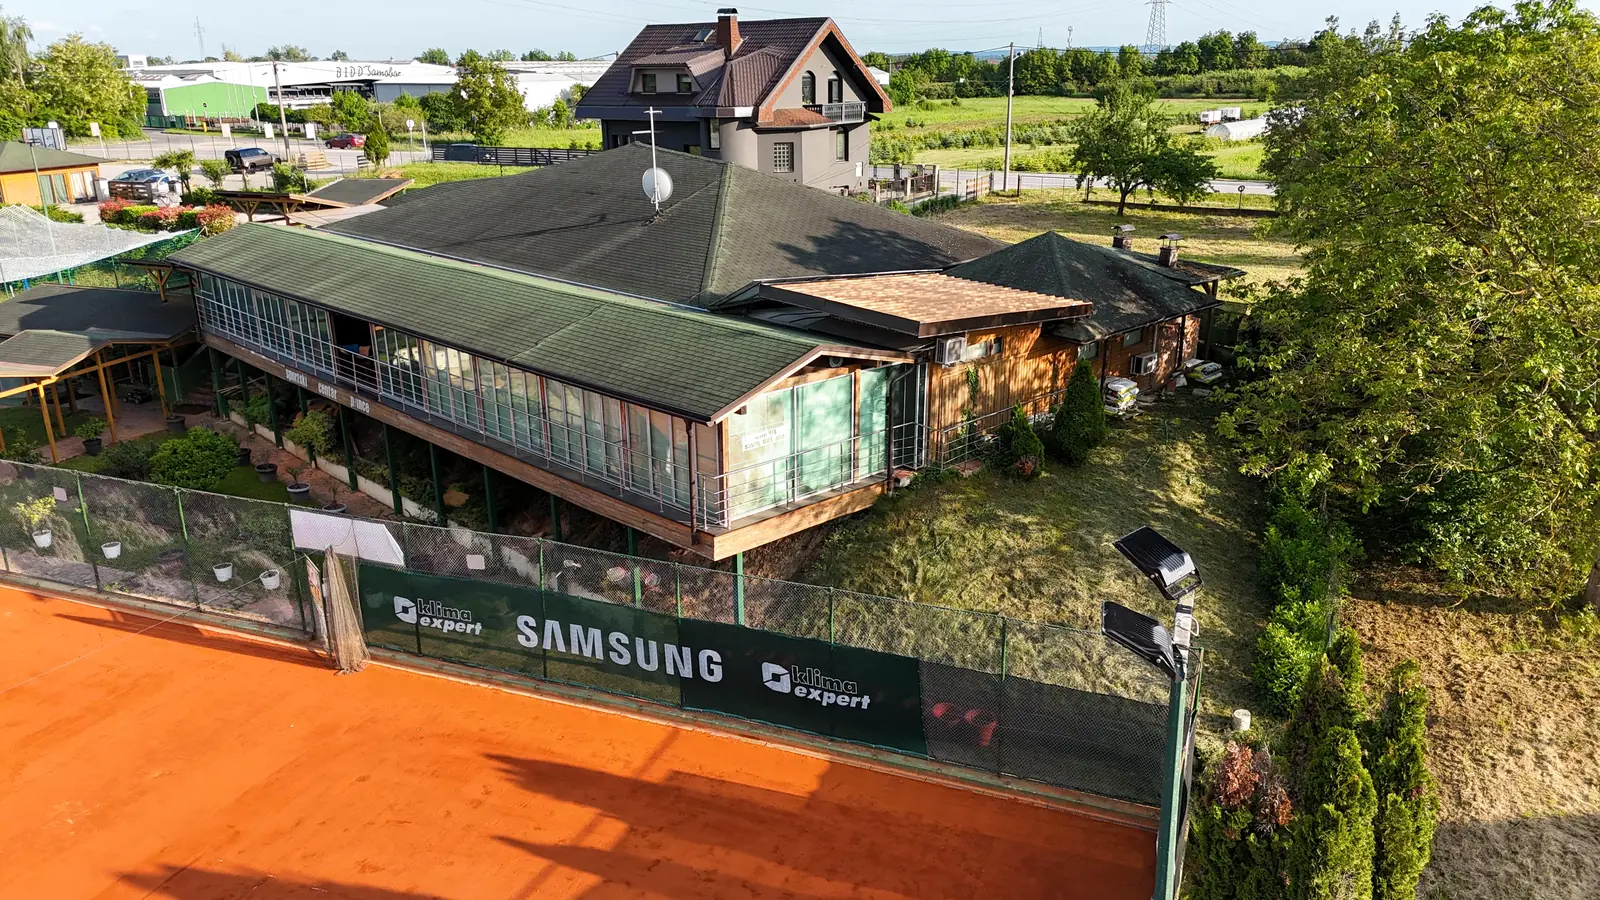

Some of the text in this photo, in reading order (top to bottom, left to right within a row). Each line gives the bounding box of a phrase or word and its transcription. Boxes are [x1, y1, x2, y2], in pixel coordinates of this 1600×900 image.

[336, 65, 364, 78] BIDD
[318, 382, 337, 399] centar
[417, 598, 472, 622] klima
[420, 616, 482, 636] expert
[516, 615, 723, 683] SAMSUNG
[791, 664, 858, 694] klima
[794, 685, 871, 710] expert
